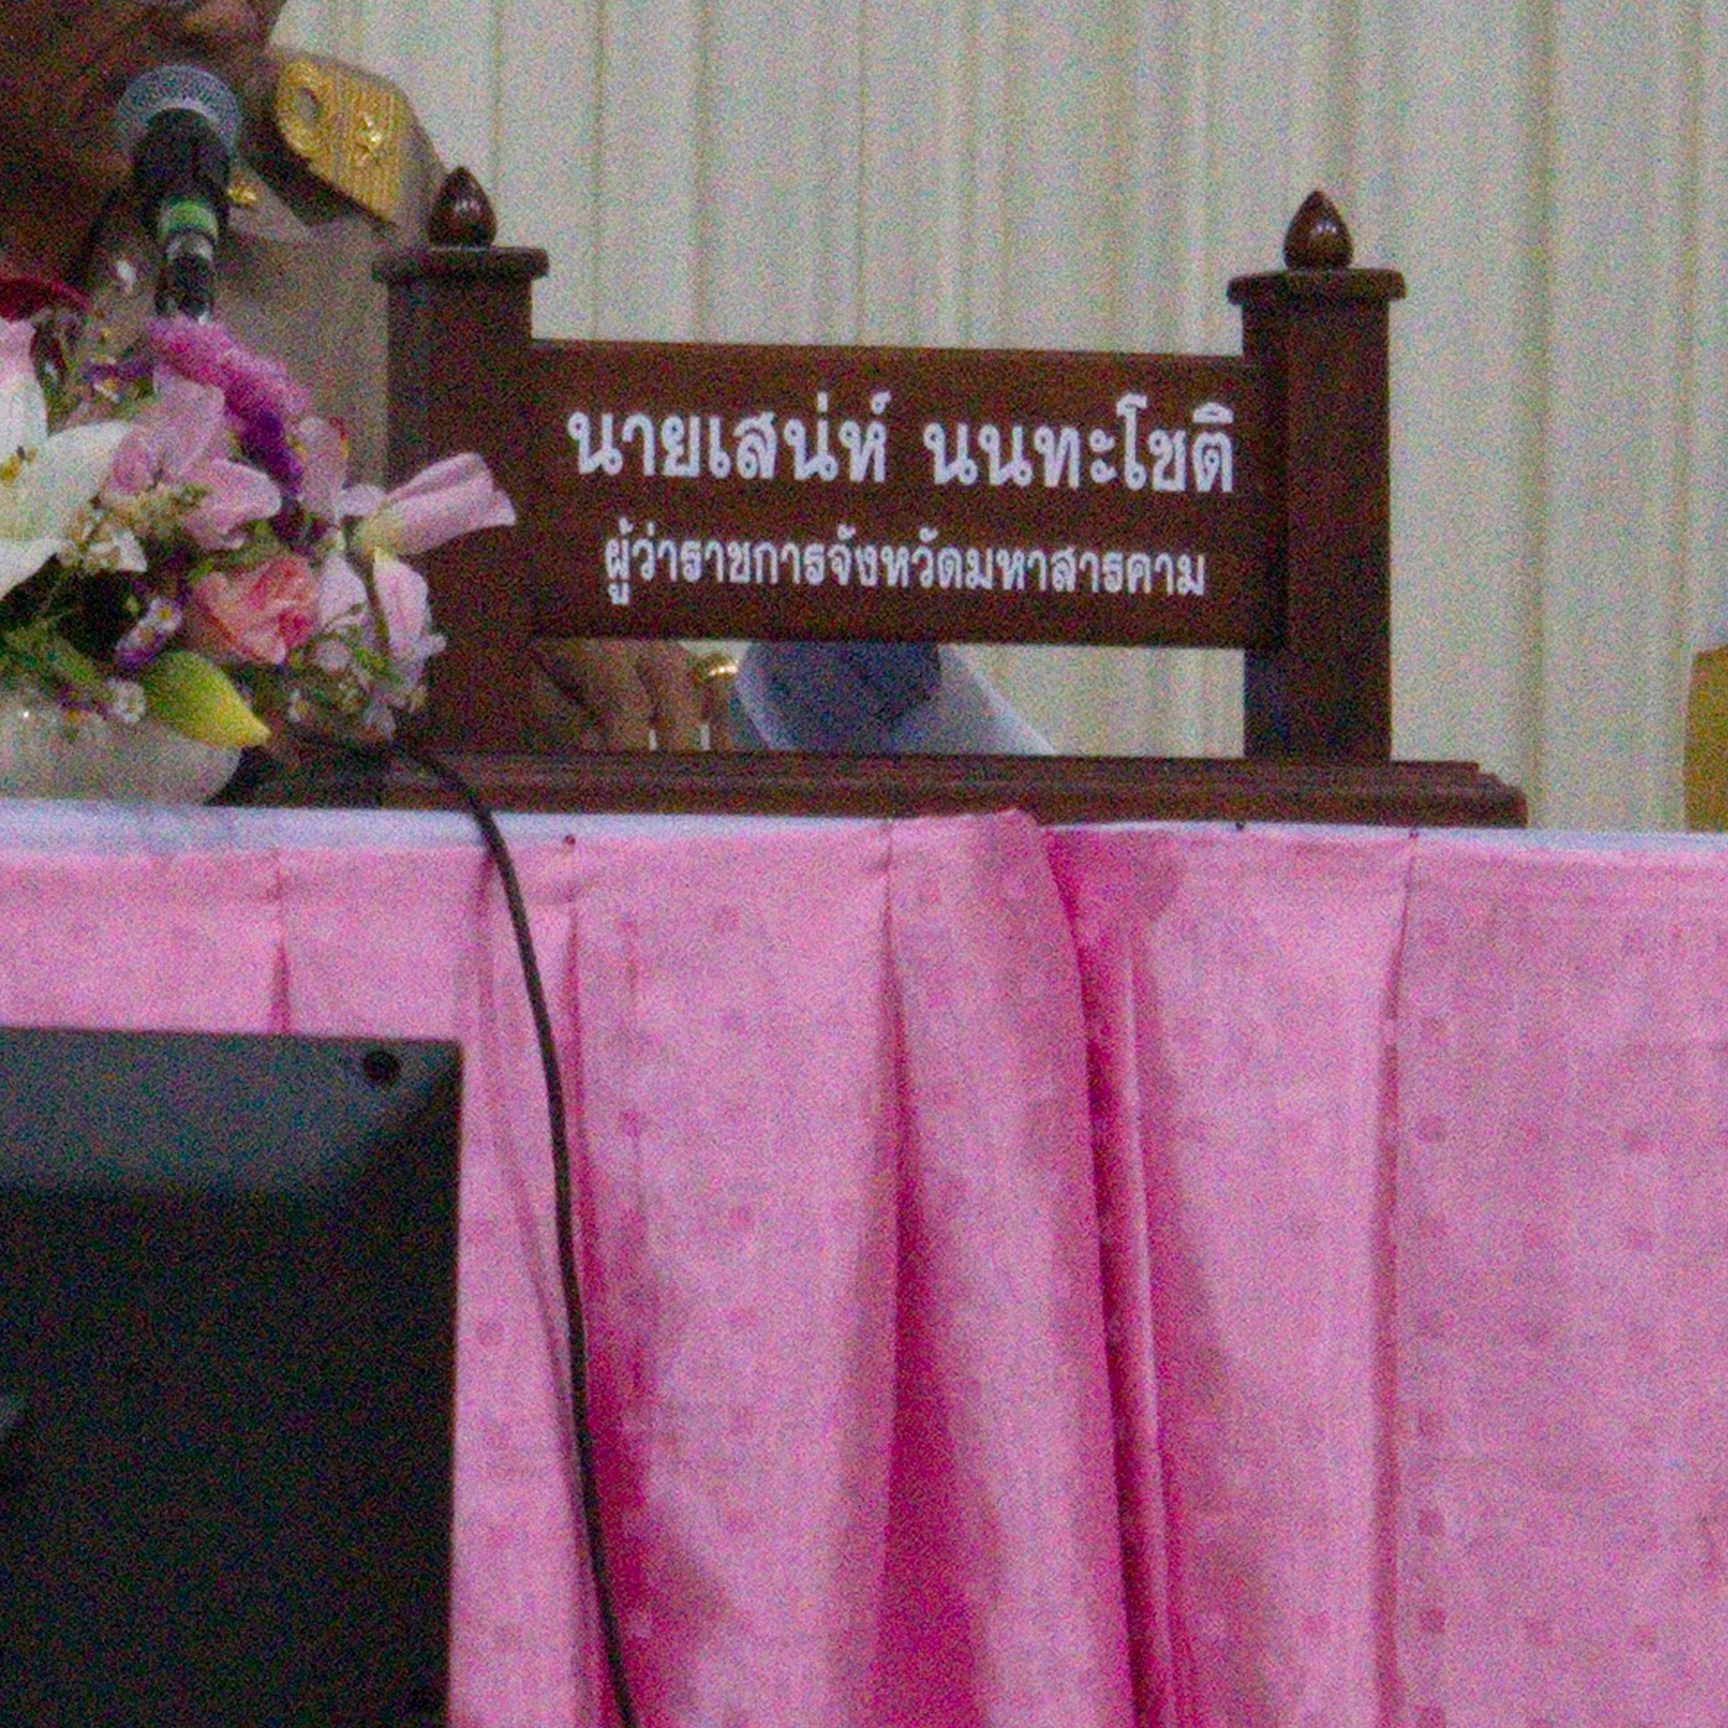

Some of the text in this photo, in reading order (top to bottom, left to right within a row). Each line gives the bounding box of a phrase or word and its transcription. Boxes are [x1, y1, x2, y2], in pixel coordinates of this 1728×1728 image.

[567, 391, 1234, 493] นายเสน่ห์ นนทะโชติ
[604, 516, 1206, 605] ผู้ว่าราชการจังหวัดมหาสารคาม
